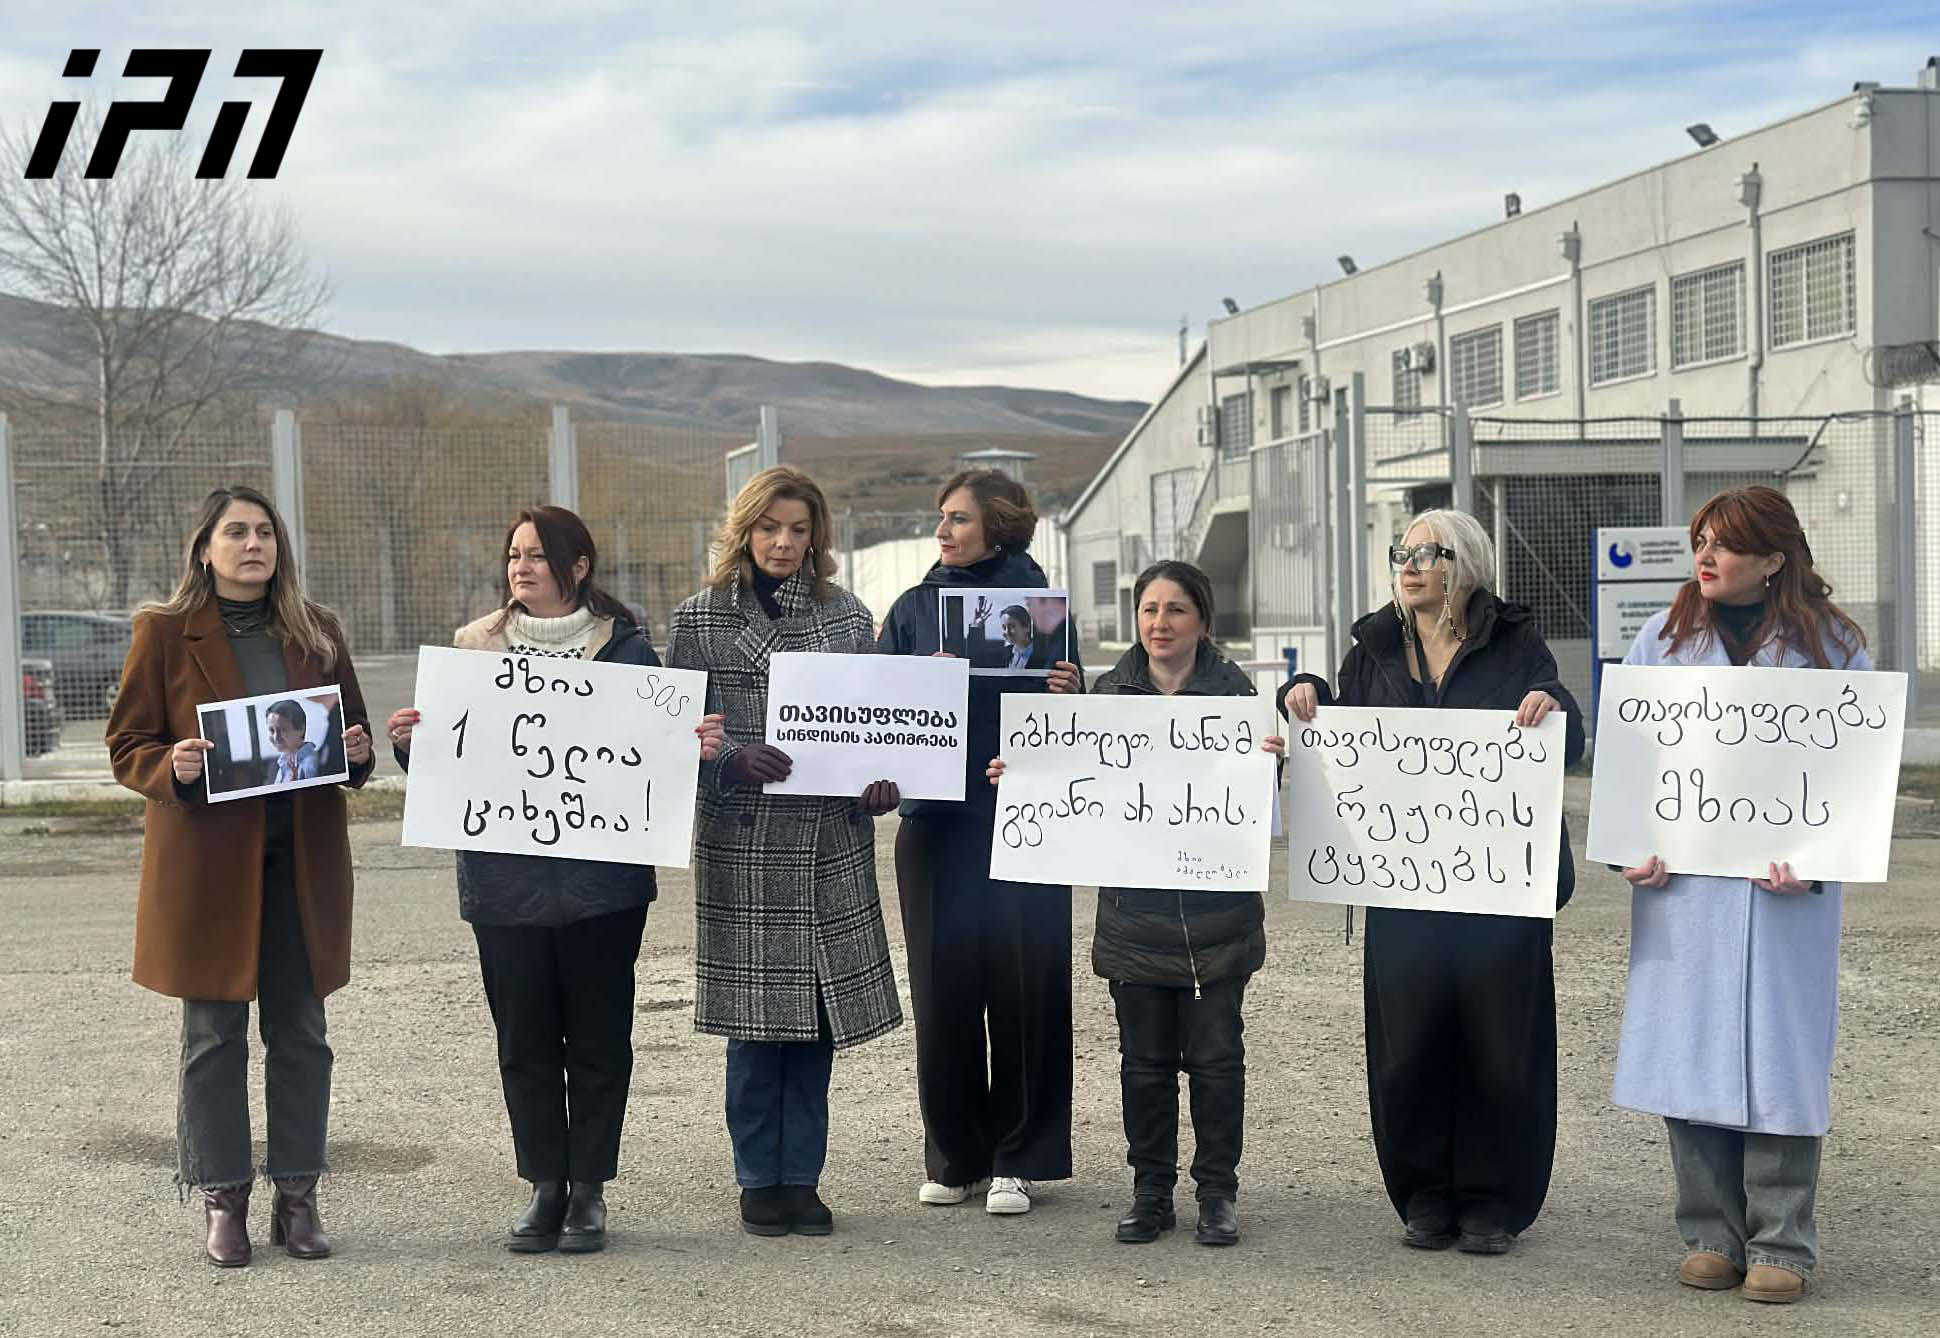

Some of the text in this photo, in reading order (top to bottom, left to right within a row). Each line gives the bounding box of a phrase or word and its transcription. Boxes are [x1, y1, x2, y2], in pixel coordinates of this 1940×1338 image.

[495, 657, 594, 696] მზია
[637, 674, 690, 717] SOS
[452, 708, 642, 783] 1 წელია
[776, 728, 958, 748] სინდისის პატიმრებს
[779, 704, 958, 729] თავისუფლება
[1170, 715, 1252, 754] სანამ
[1618, 684, 1887, 749] თავისუფლება
[1301, 717, 1547, 782] თავისუფლება
[1002, 776, 1257, 848] გვიანი არ არის.
[1337, 784, 1534, 844] რეჟიმის
[1655, 768, 1830, 826] მზიას
